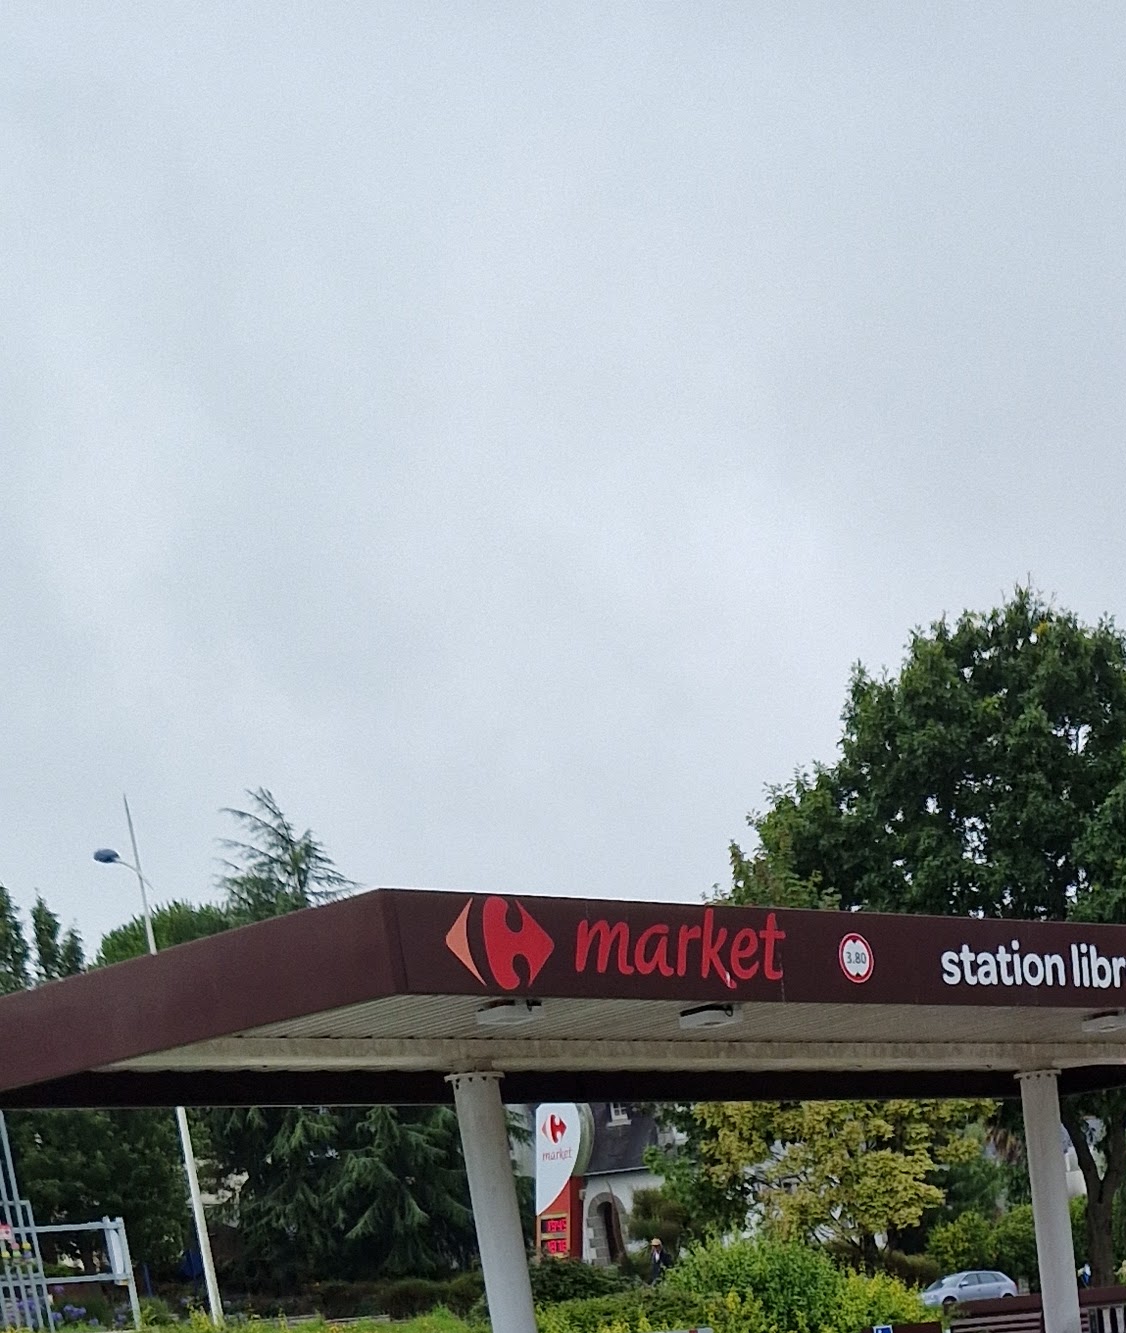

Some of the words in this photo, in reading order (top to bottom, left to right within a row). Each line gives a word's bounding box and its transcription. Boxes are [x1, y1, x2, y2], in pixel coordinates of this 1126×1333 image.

[576, 908, 786, 988] market
[846, 951, 867, 965] 3.80
[940, 939, 1066, 987] station
[542, 1147, 572, 1161] market
